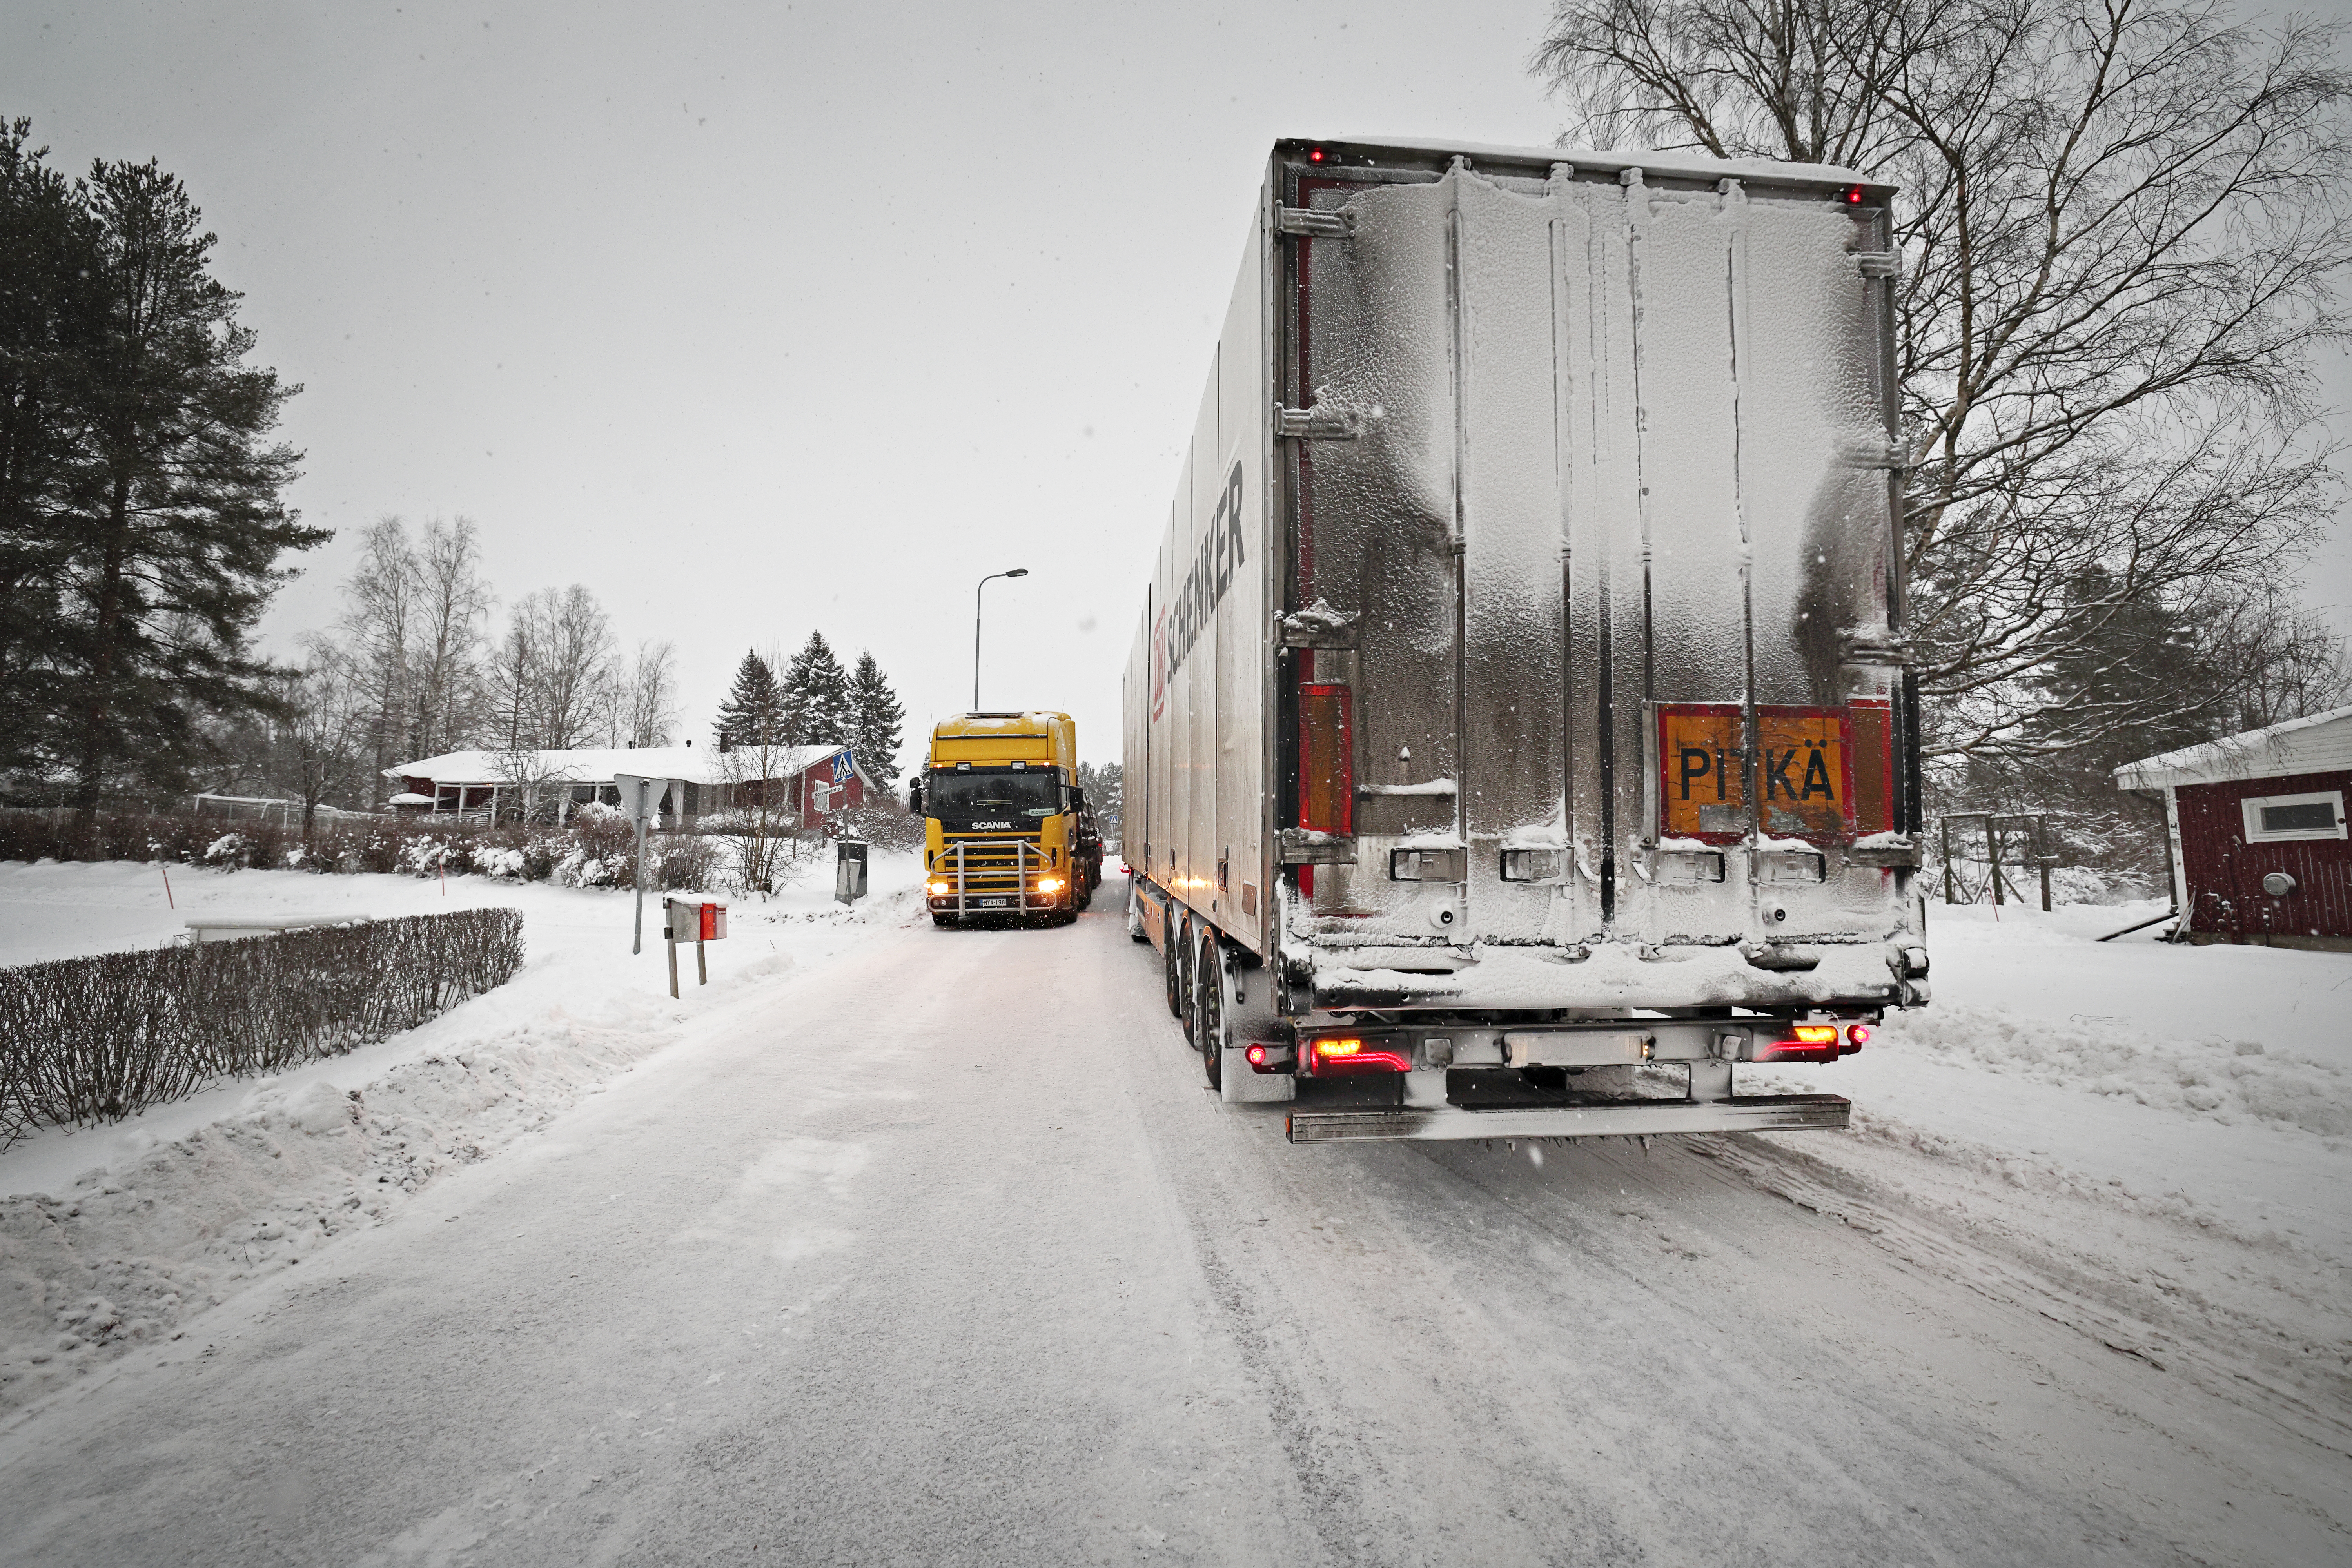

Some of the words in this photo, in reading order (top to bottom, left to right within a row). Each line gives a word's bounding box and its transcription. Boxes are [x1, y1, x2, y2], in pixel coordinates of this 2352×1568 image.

[1154, 623, 1164, 708] DB
[1168, 460, 1245, 685] SCHENKER
[1680, 739, 1835, 801] PITKÄ
